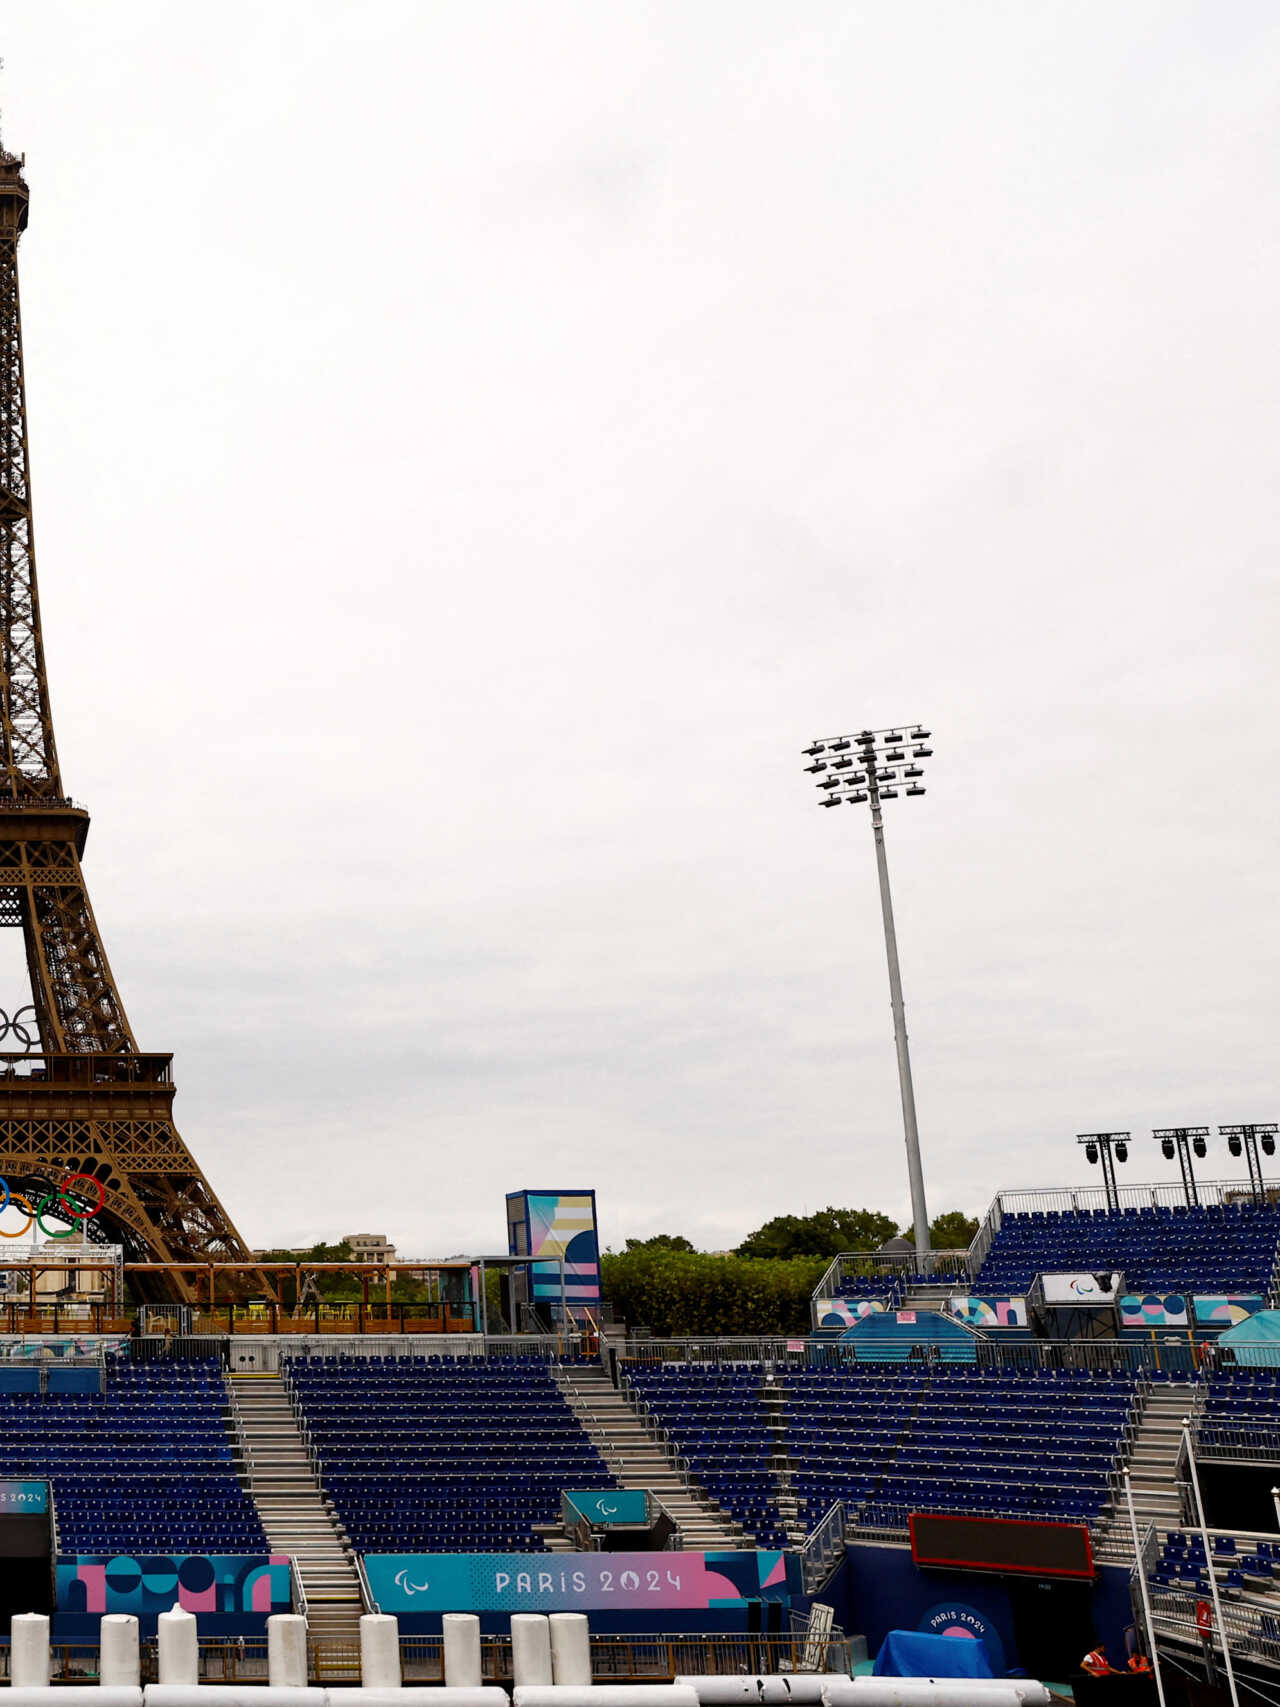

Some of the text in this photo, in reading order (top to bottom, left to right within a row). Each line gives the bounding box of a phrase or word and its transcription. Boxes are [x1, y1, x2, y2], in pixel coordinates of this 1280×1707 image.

[10, 1493, 41, 1502] 2024
[599, 1570, 681, 1592] 2024
[960, 1612, 985, 1633] 2024
